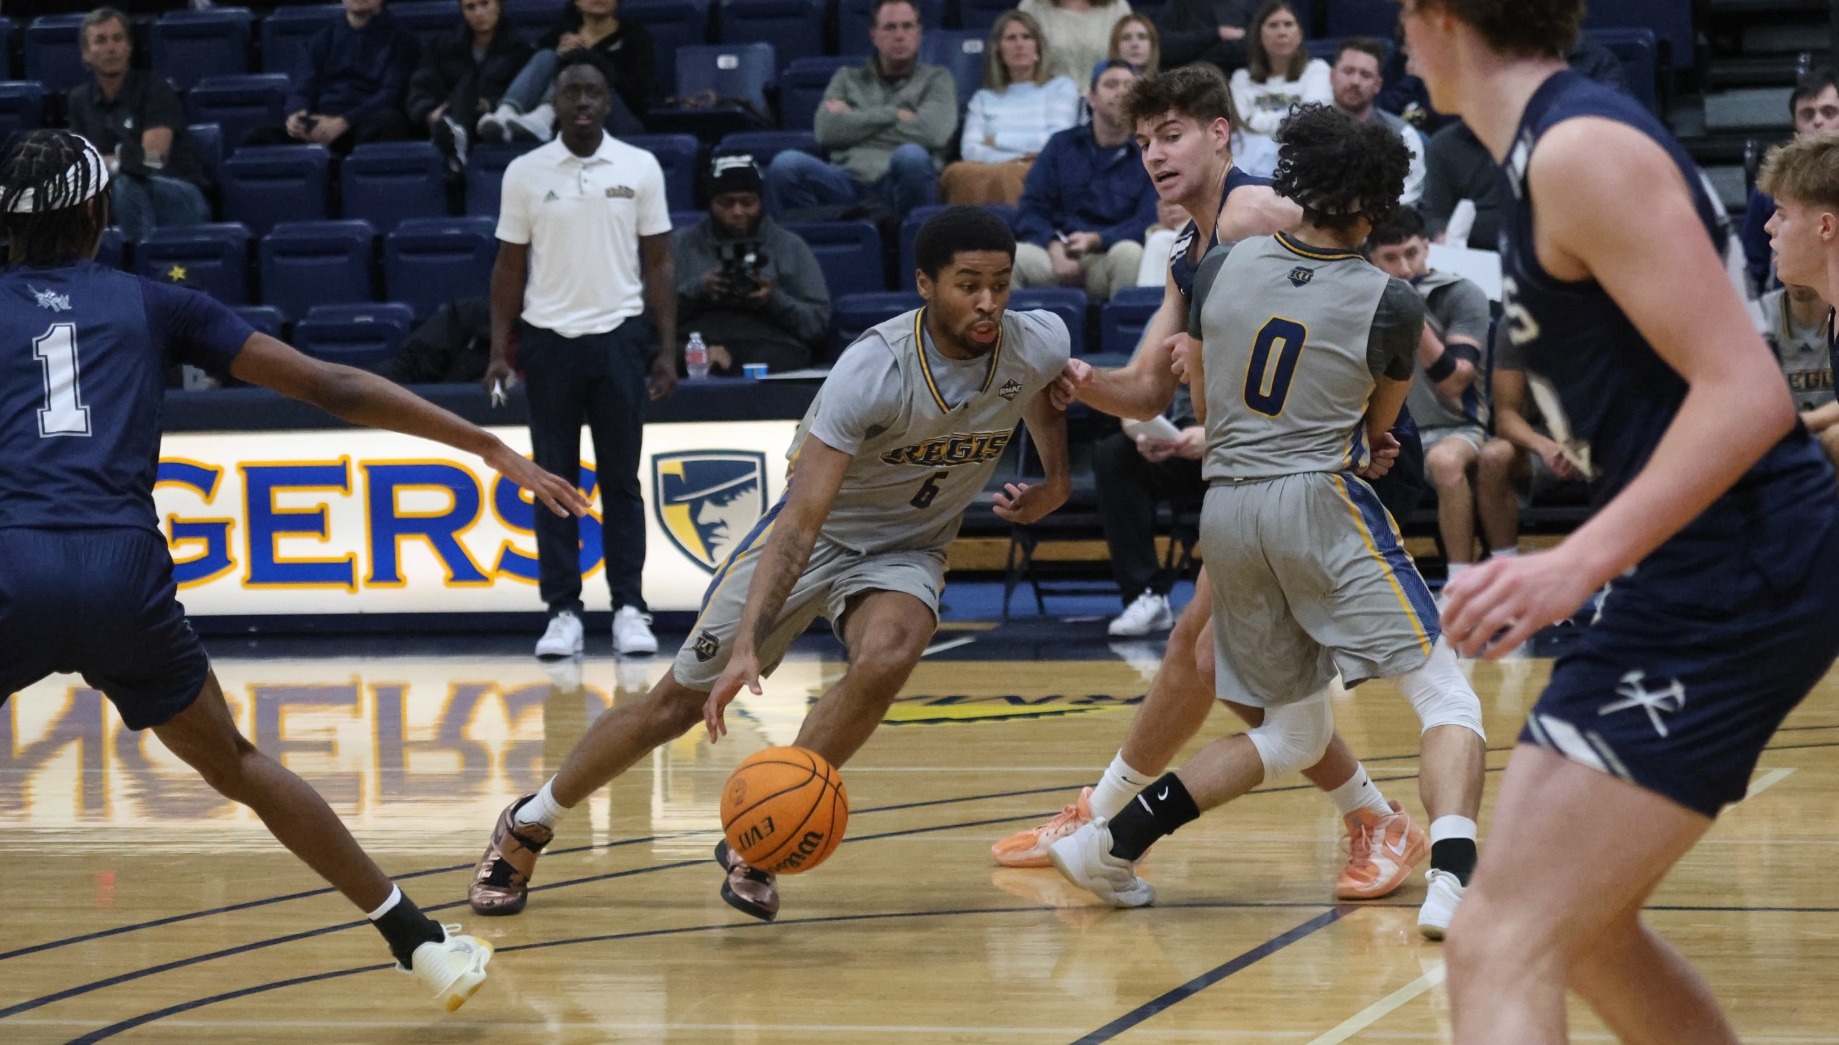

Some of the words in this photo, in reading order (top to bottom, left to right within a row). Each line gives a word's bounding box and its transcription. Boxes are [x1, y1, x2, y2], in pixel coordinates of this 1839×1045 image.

[32, 322, 92, 438] 1
[1243, 315, 1308, 419] 0
[880, 429, 1012, 467] REGIS
[910, 471, 949, 509] 6
